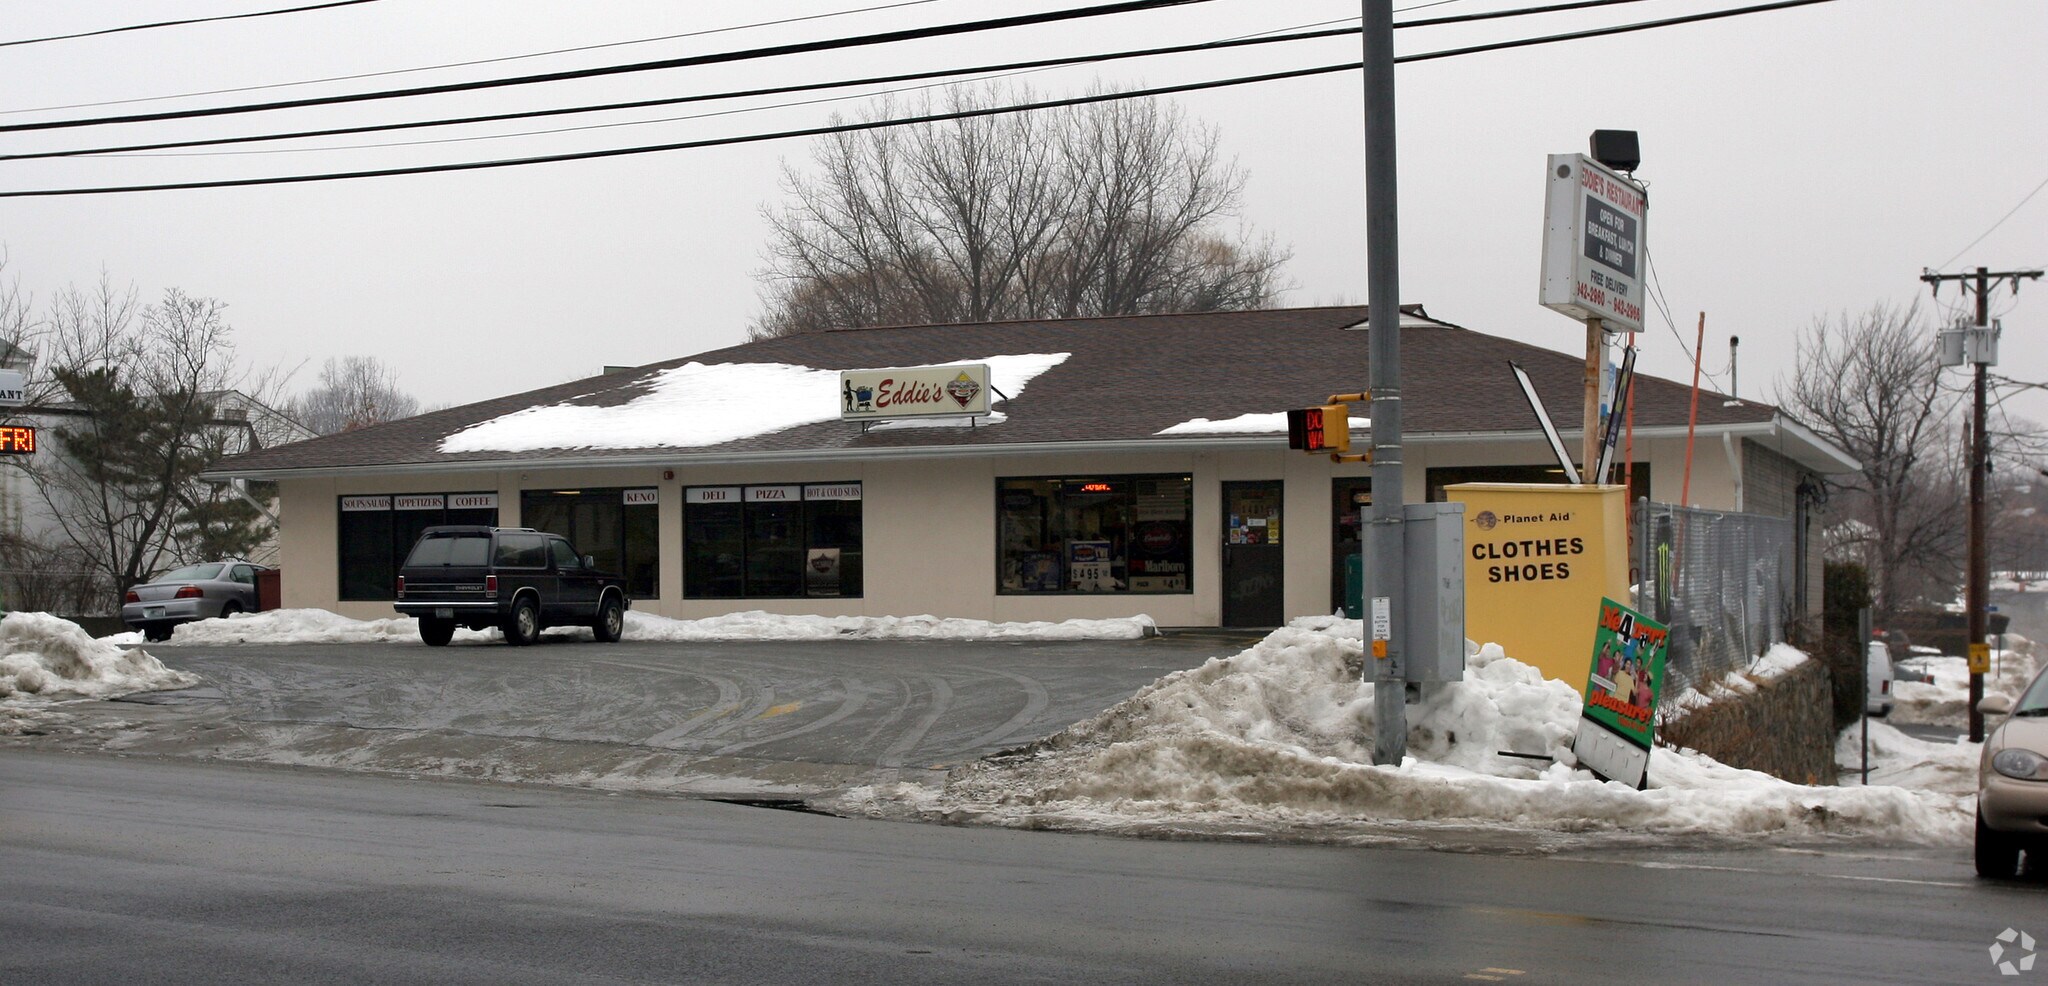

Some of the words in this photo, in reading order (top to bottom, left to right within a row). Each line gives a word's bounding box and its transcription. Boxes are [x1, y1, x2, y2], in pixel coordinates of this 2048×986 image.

[1582, 167, 1604, 196] EDDIE'S
[1606, 180, 1644, 217] RESTAURANT
[1600, 208, 1614, 227] OPEN
[1614, 215, 1625, 232] FOR
[1588, 221, 1617, 249] BREAKFAST,
[1618, 236, 1634, 255] LUNCH
[1599, 245, 1603, 259] &
[1605, 247, 1623, 267] DINNER
[1590, 269, 1603, 287] FREE
[1605, 276, 1628, 297] DELIVERY
[876, 378, 944, 408] Eddie's
[0, 428, 33, 451] FRI
[398, 498, 443, 507] APPETIZERS
[455, 497, 491, 506] COFFEE
[626, 492, 655, 502] KENO
[702, 491, 726, 500] DELI
[755, 490, 786, 499] PIZZA
[807, 488, 820, 497] HOT
[827, 488, 842, 497] COLD
[844, 487, 859, 496] SUBS
[1504, 513, 1544, 523] Planet
[1549, 513, 1570, 522] Aid
[1472, 537, 1584, 560] CLOTHES
[1144, 559, 1185, 572] Marlboro
[1488, 562, 1570, 583] SHOES
